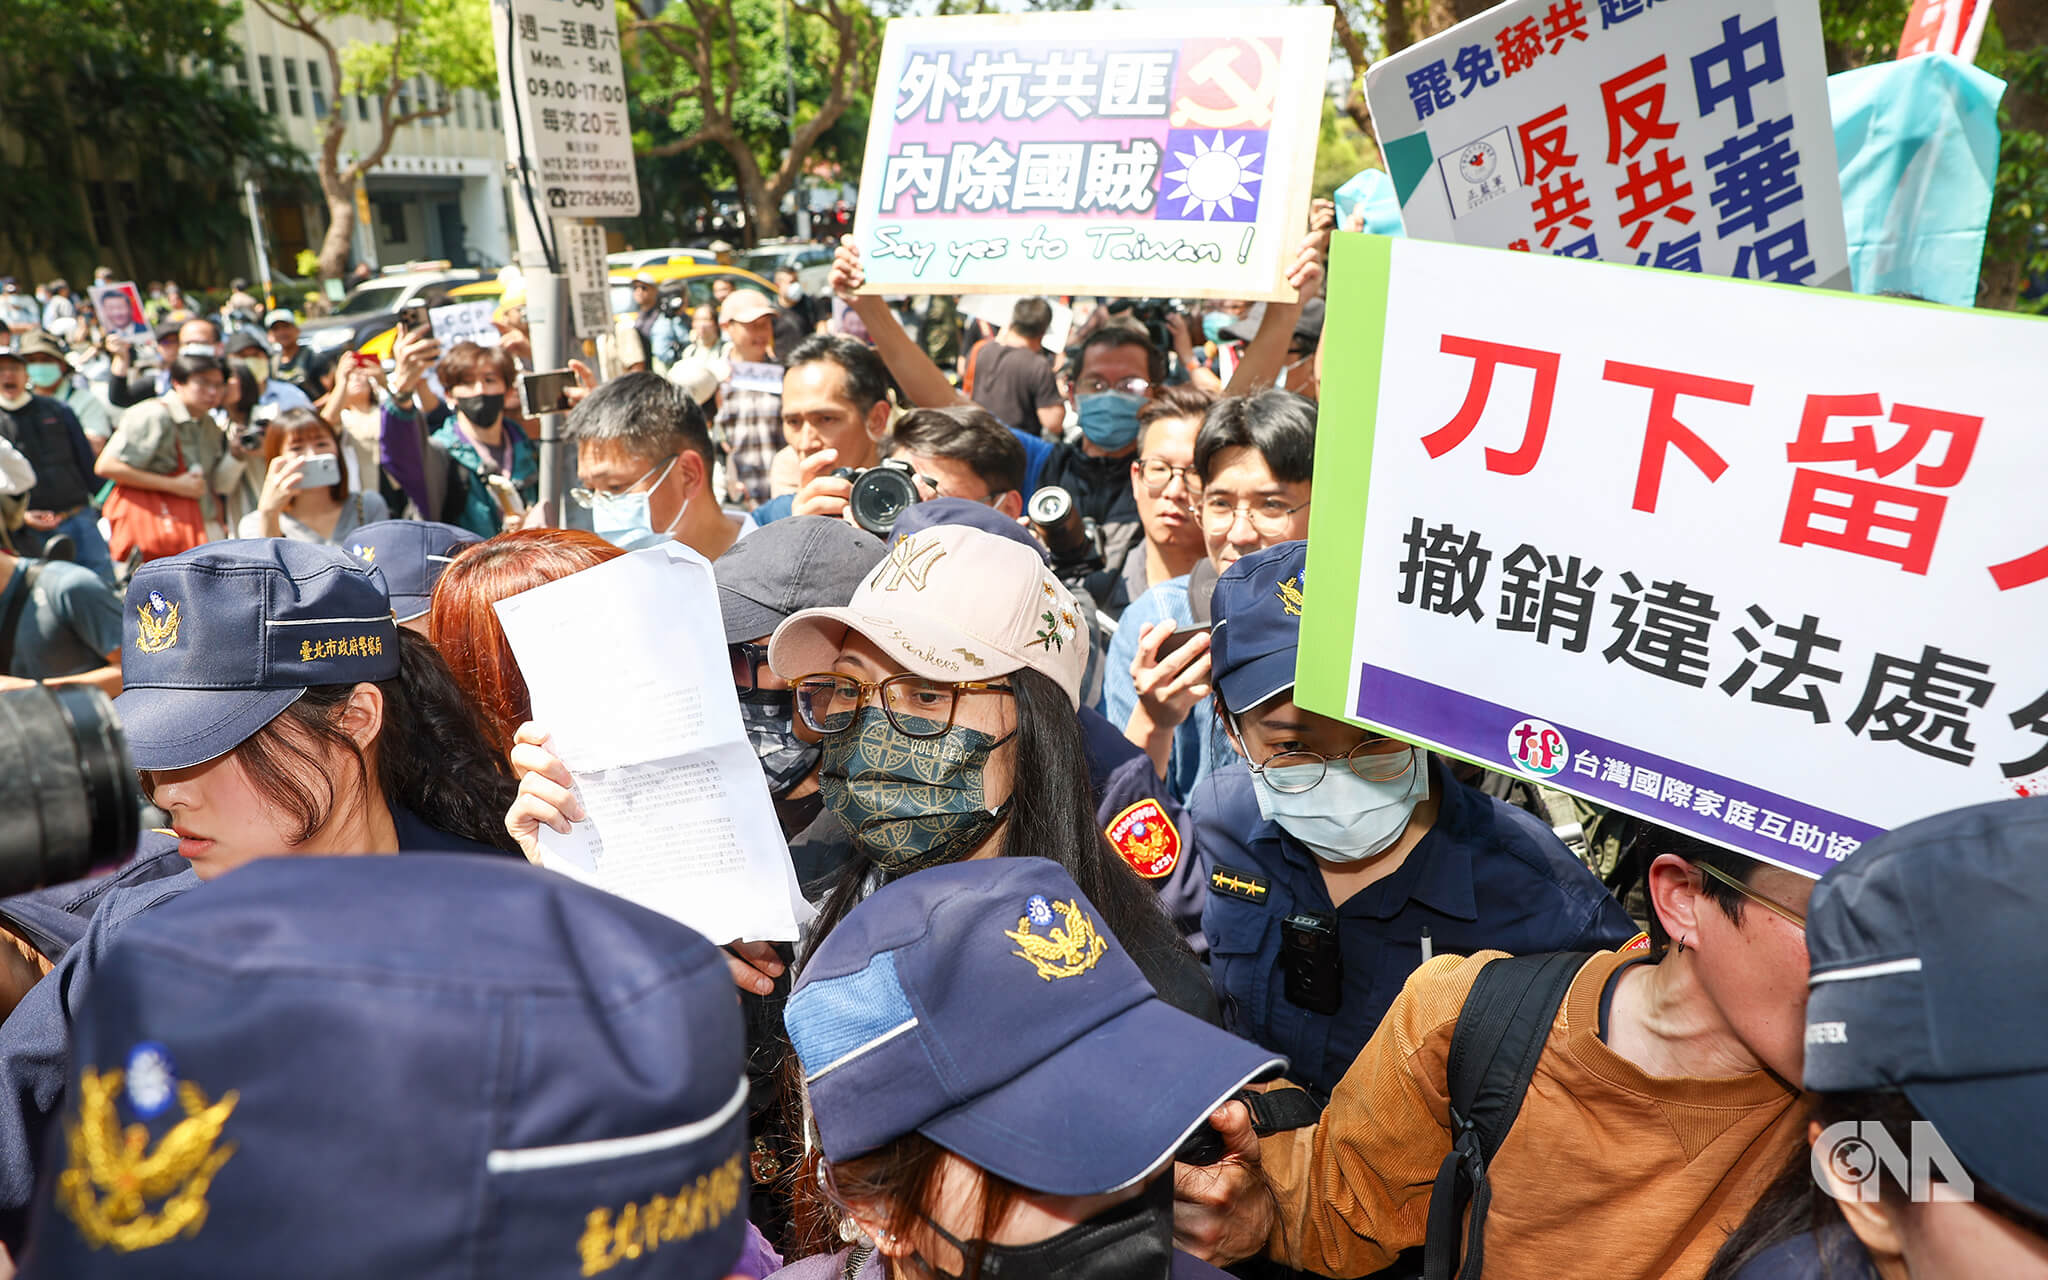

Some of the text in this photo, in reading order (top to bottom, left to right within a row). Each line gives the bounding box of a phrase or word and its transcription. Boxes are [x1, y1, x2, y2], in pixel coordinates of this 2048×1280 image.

[519, 14, 617, 51] 週一至週六
[896, 49, 1176, 121] 外抗共匪
[542, 108, 621, 137] 每次20元
[881, 140, 1162, 214] 內除國賊
[871, 226, 936, 277] Say
[948, 231, 1008, 277] yes
[1022, 225, 1069, 260] to
[1085, 226, 1222, 264] Taiwan
[299, 635, 383, 662] 臺北市政府警察局
